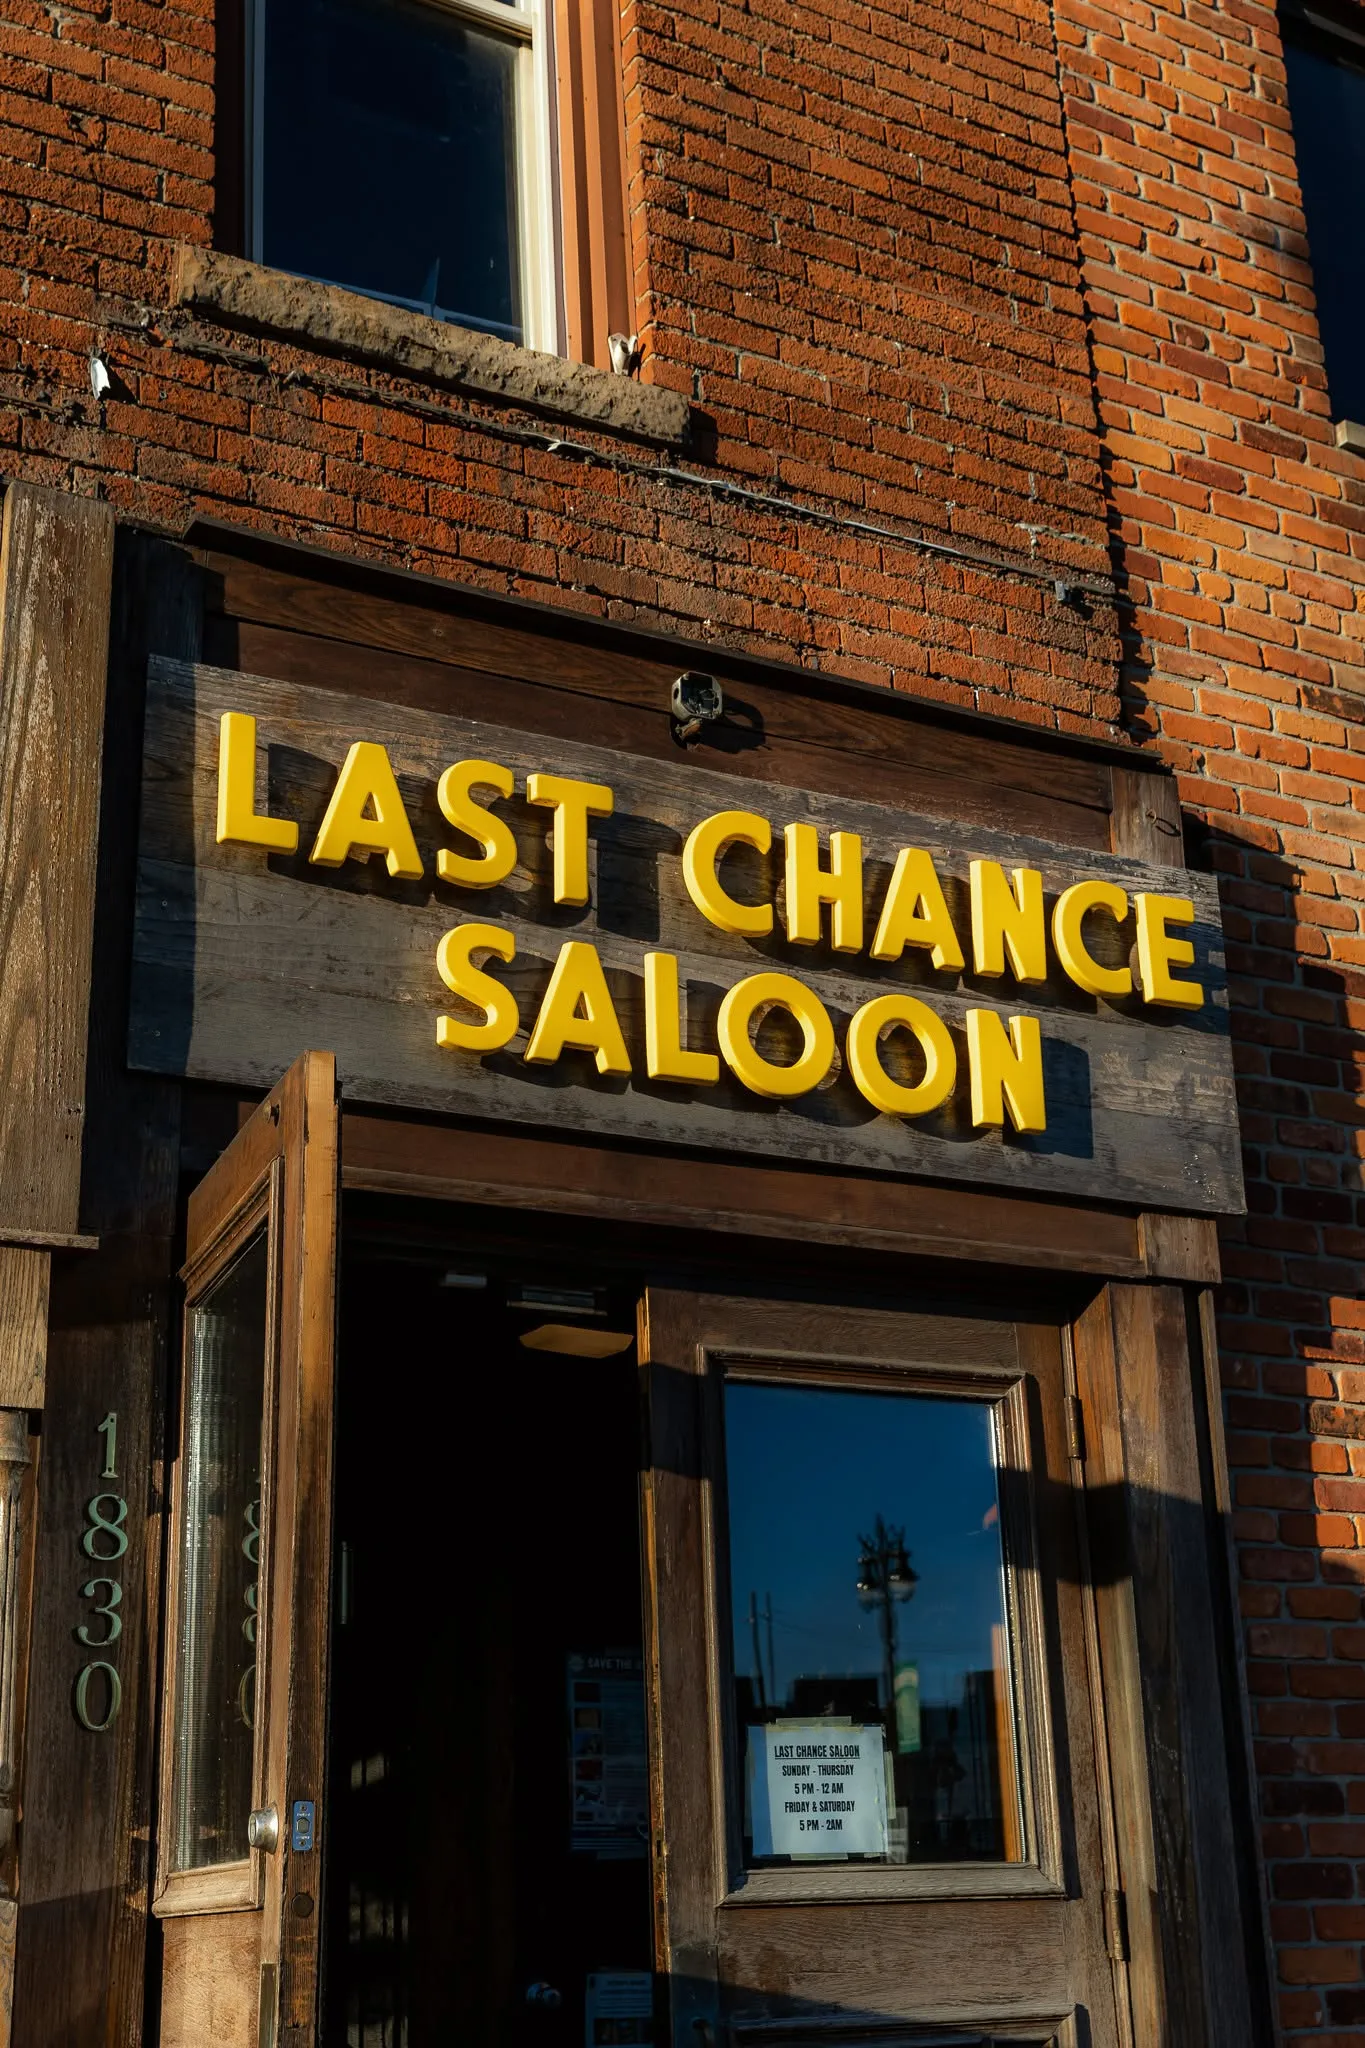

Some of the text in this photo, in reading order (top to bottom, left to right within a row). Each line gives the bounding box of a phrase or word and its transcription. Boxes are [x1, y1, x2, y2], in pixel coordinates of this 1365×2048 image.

[216, 712, 1205, 1009] LAST CHANCE
[435, 922, 1047, 1134] SALOON
[76, 1412, 129, 1732] 1830
[774, 1744, 860, 1757] LAST CHANCE SALOON
[782, 1765, 810, 1776] SUNDAY
[818, 1764, 854, 1776] THURSDAY
[794, 1783, 800, 1794] 5
[801, 1783, 814, 1794] PM
[821, 1783, 829, 1794] 12
[831, 1783, 844, 1794] AM
[784, 1801, 855, 1813] FRIDAY & SATURDAY
[799, 1820, 805, 1831] 5
[806, 1819, 819, 1831] PM
[826, 1819, 843, 1831] 2AM
